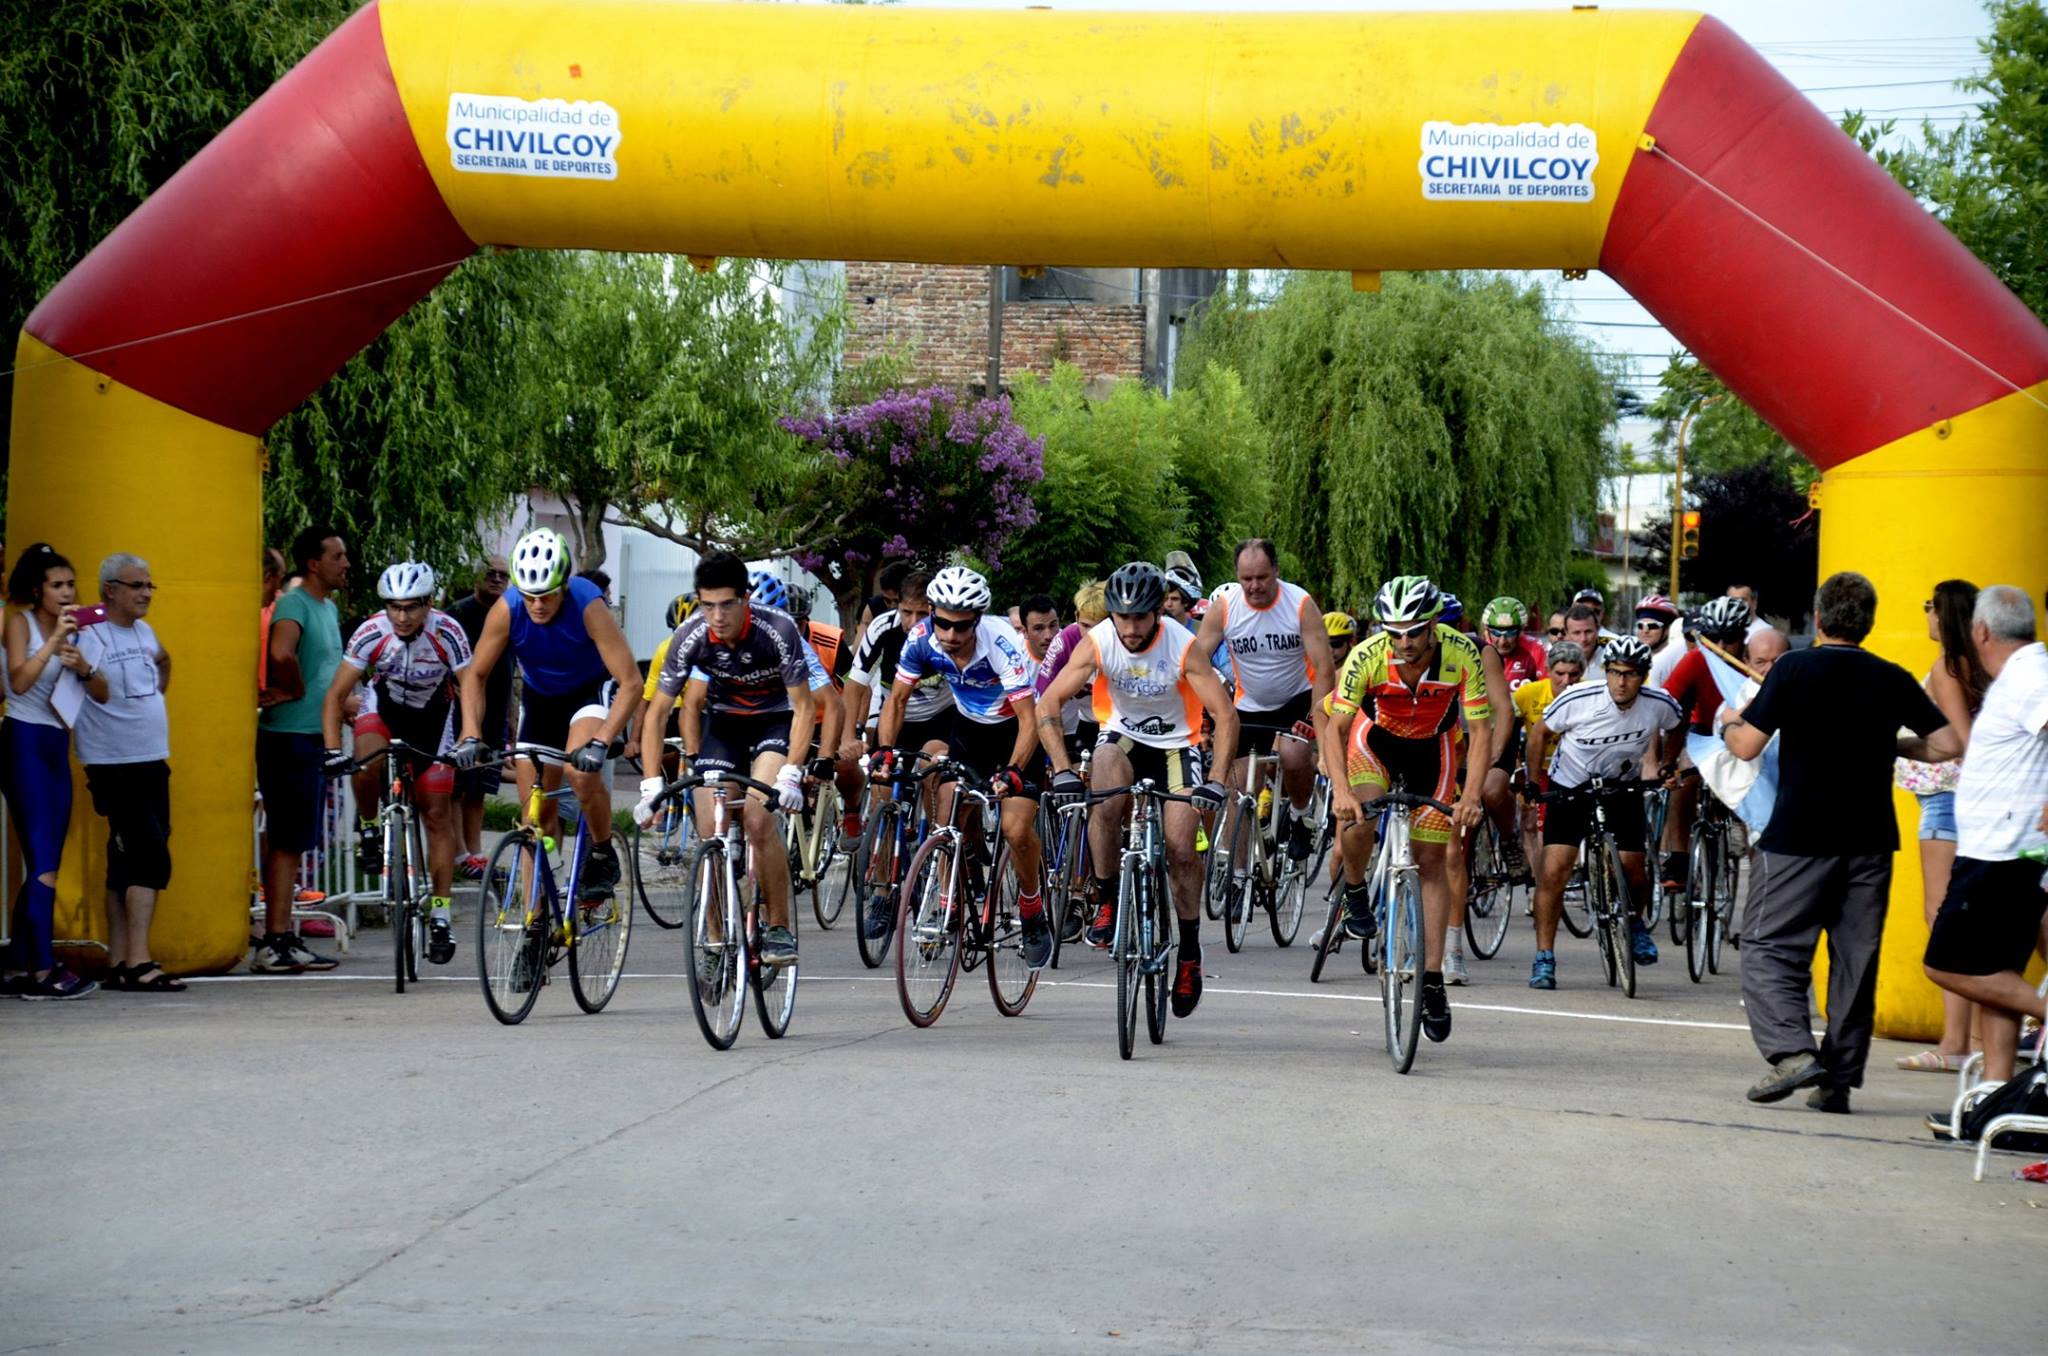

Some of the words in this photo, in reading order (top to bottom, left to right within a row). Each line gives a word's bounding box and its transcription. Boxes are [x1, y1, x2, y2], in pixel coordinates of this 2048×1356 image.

[455, 101, 582, 125] Municipalidad
[588, 109, 611, 126] de
[454, 127, 612, 158] CHIVILCOY
[1428, 129, 1560, 150] Municipalidad
[1566, 132, 1590, 148] de
[456, 154, 528, 169] SECRETARIA
[534, 159, 549, 170] DE
[553, 160, 612, 174] DEPORTES
[1426, 155, 1591, 180] CHIVILCOY
[1429, 183, 1501, 195] SECRETARIA
[1508, 184, 1523, 195] DE
[1528, 184, 1588, 197] DEPORTES
[1232, 636, 1257, 655] AGRO
[1576, 728, 1647, 746] SCOTT
